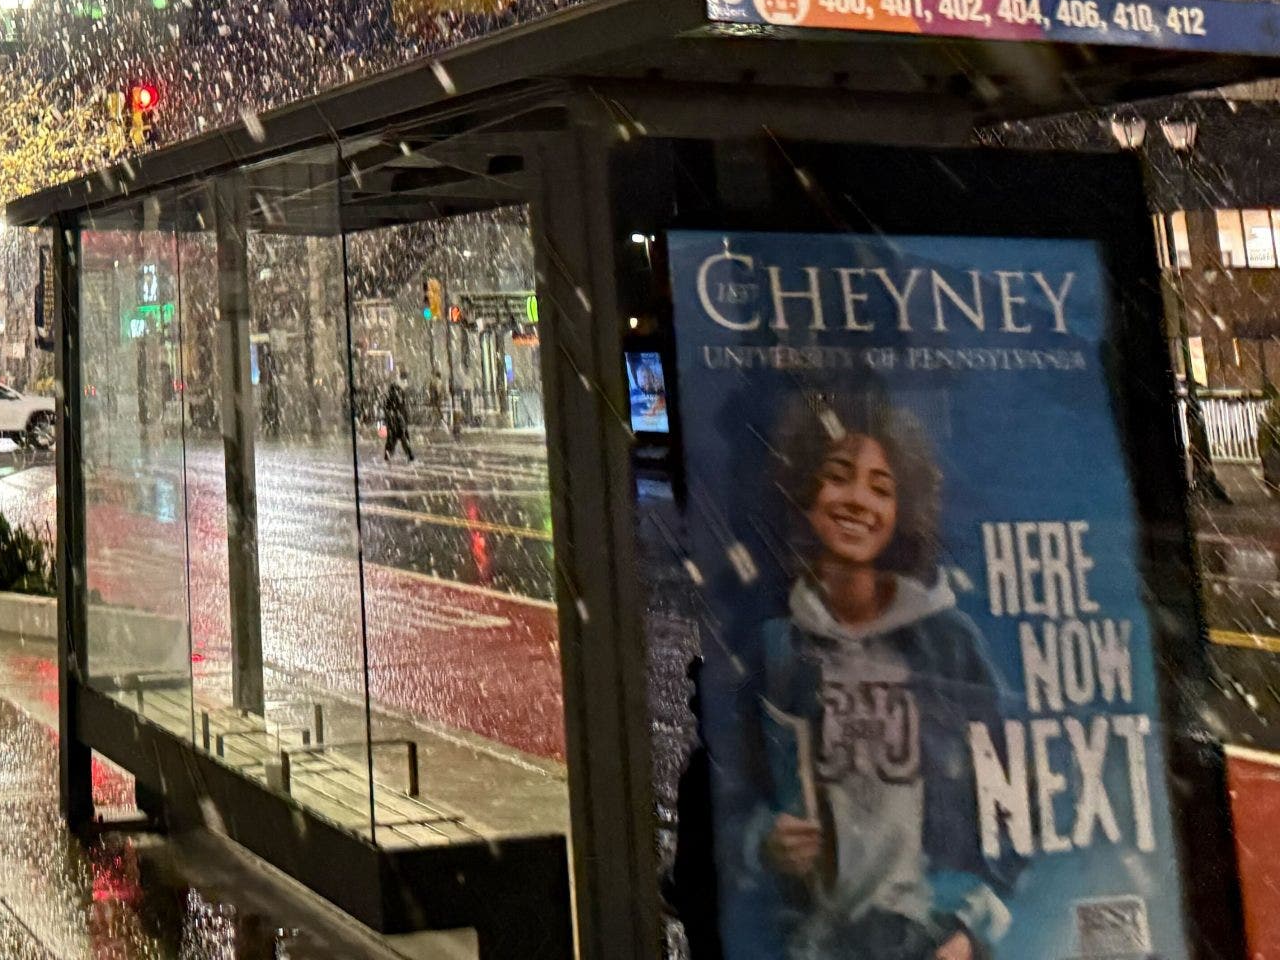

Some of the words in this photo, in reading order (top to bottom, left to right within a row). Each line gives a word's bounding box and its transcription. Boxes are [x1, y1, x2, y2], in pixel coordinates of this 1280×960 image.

[1056, 0, 1109, 33] 406,
[1113, 2, 1161, 38] 410,
[1166, 6, 1206, 37] 412
[697, 250, 1075, 336] CHEYNEY
[981, 521, 1100, 619] HERE
[1019, 618, 1132, 713] NOW
[968, 714, 1155, 859] NEXT
